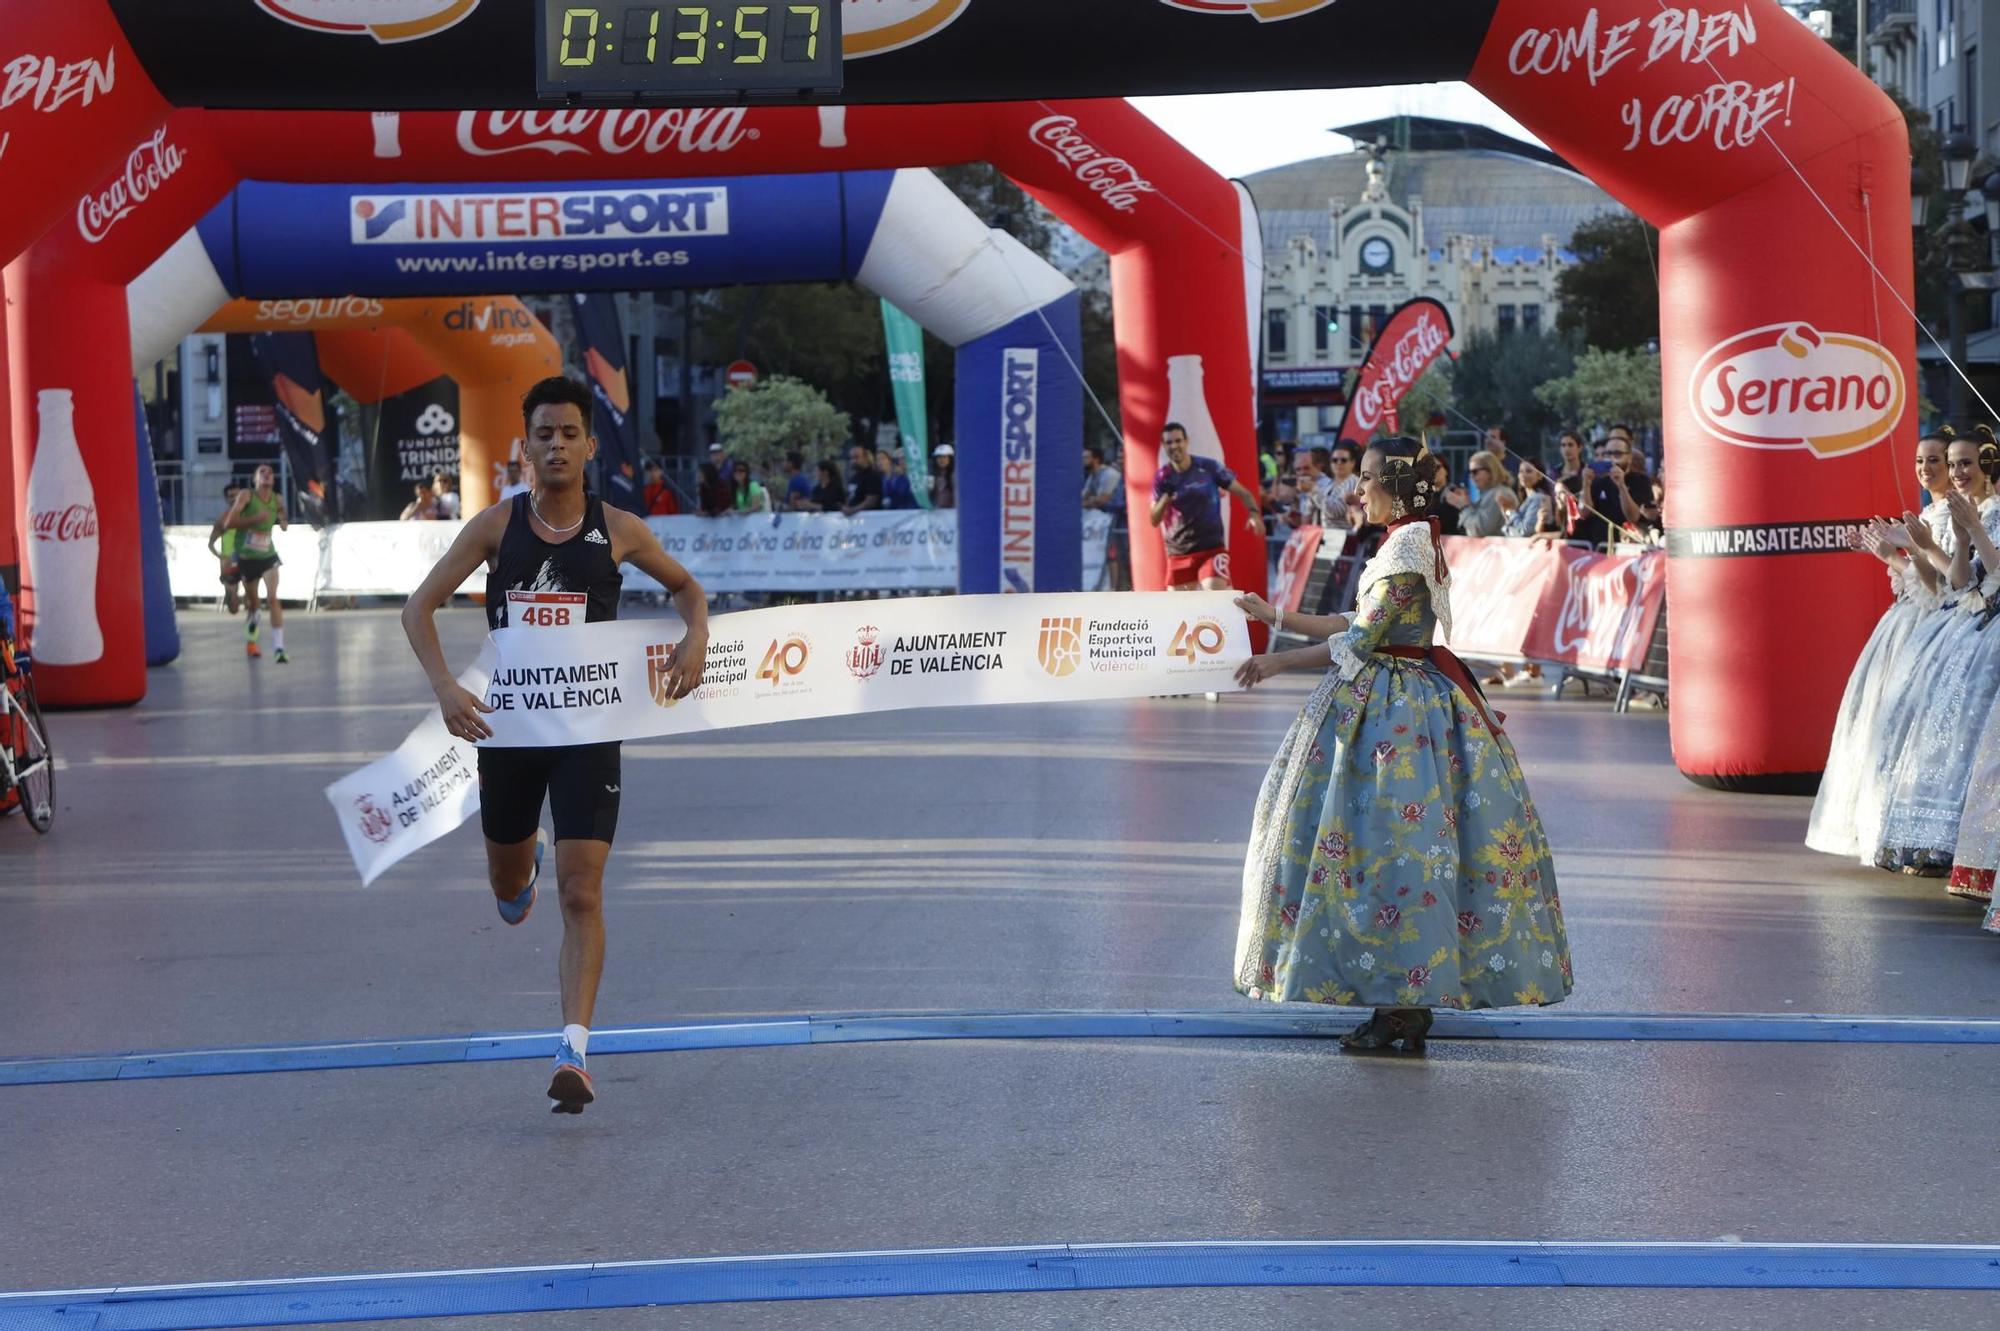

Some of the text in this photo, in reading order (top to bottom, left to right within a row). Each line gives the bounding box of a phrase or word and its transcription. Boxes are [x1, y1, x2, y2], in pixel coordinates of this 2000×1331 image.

[560, 6, 820, 66] 0:13:57
[1508, 2, 1756, 87] COME BIEN
[0, 45, 115, 113] BIEN
[1650, 76, 1796, 151] CORRE!
[456, 106, 748, 157] CocaCola
[1029, 115, 1158, 211] Coca-Cola
[77, 122, 184, 244] Coca-Cola
[415, 191, 715, 239] INTERSPORT
[396, 248, 690, 273] www.intersport.es
[256, 296, 384, 325] seguros
[1710, 364, 1892, 417] Serrano
[398, 435, 458, 449] FUNDACI
[400, 462, 458, 480] ALFON
[1003, 357, 1034, 562] INTERSPORT
[584, 535, 608, 545] adidas
[521, 606, 570, 626] 468
[1088, 619, 1149, 631] Fundació
[705, 639, 744, 655] ndació
[894, 631, 1007, 653] AJUNTAMENT
[1088, 634, 1153, 646] Esportiva
[1167, 620, 1225, 665] 40
[703, 655, 746, 673] portiva
[755, 638, 809, 687] 40
[890, 652, 1004, 675] DE VALÈNCIA
[1089, 646, 1156, 660] Municipal
[492, 661, 619, 686] AJUNTAMENT
[701, 668, 748, 686] unicipal
[1089, 660, 1149, 672] València
[491, 686, 622, 711] DE VALÈNCIA
[691, 685, 740, 701] València
[392, 746, 461, 808] AJUNTAMENT
[398, 766, 473, 828] DE VALÈNCIA
